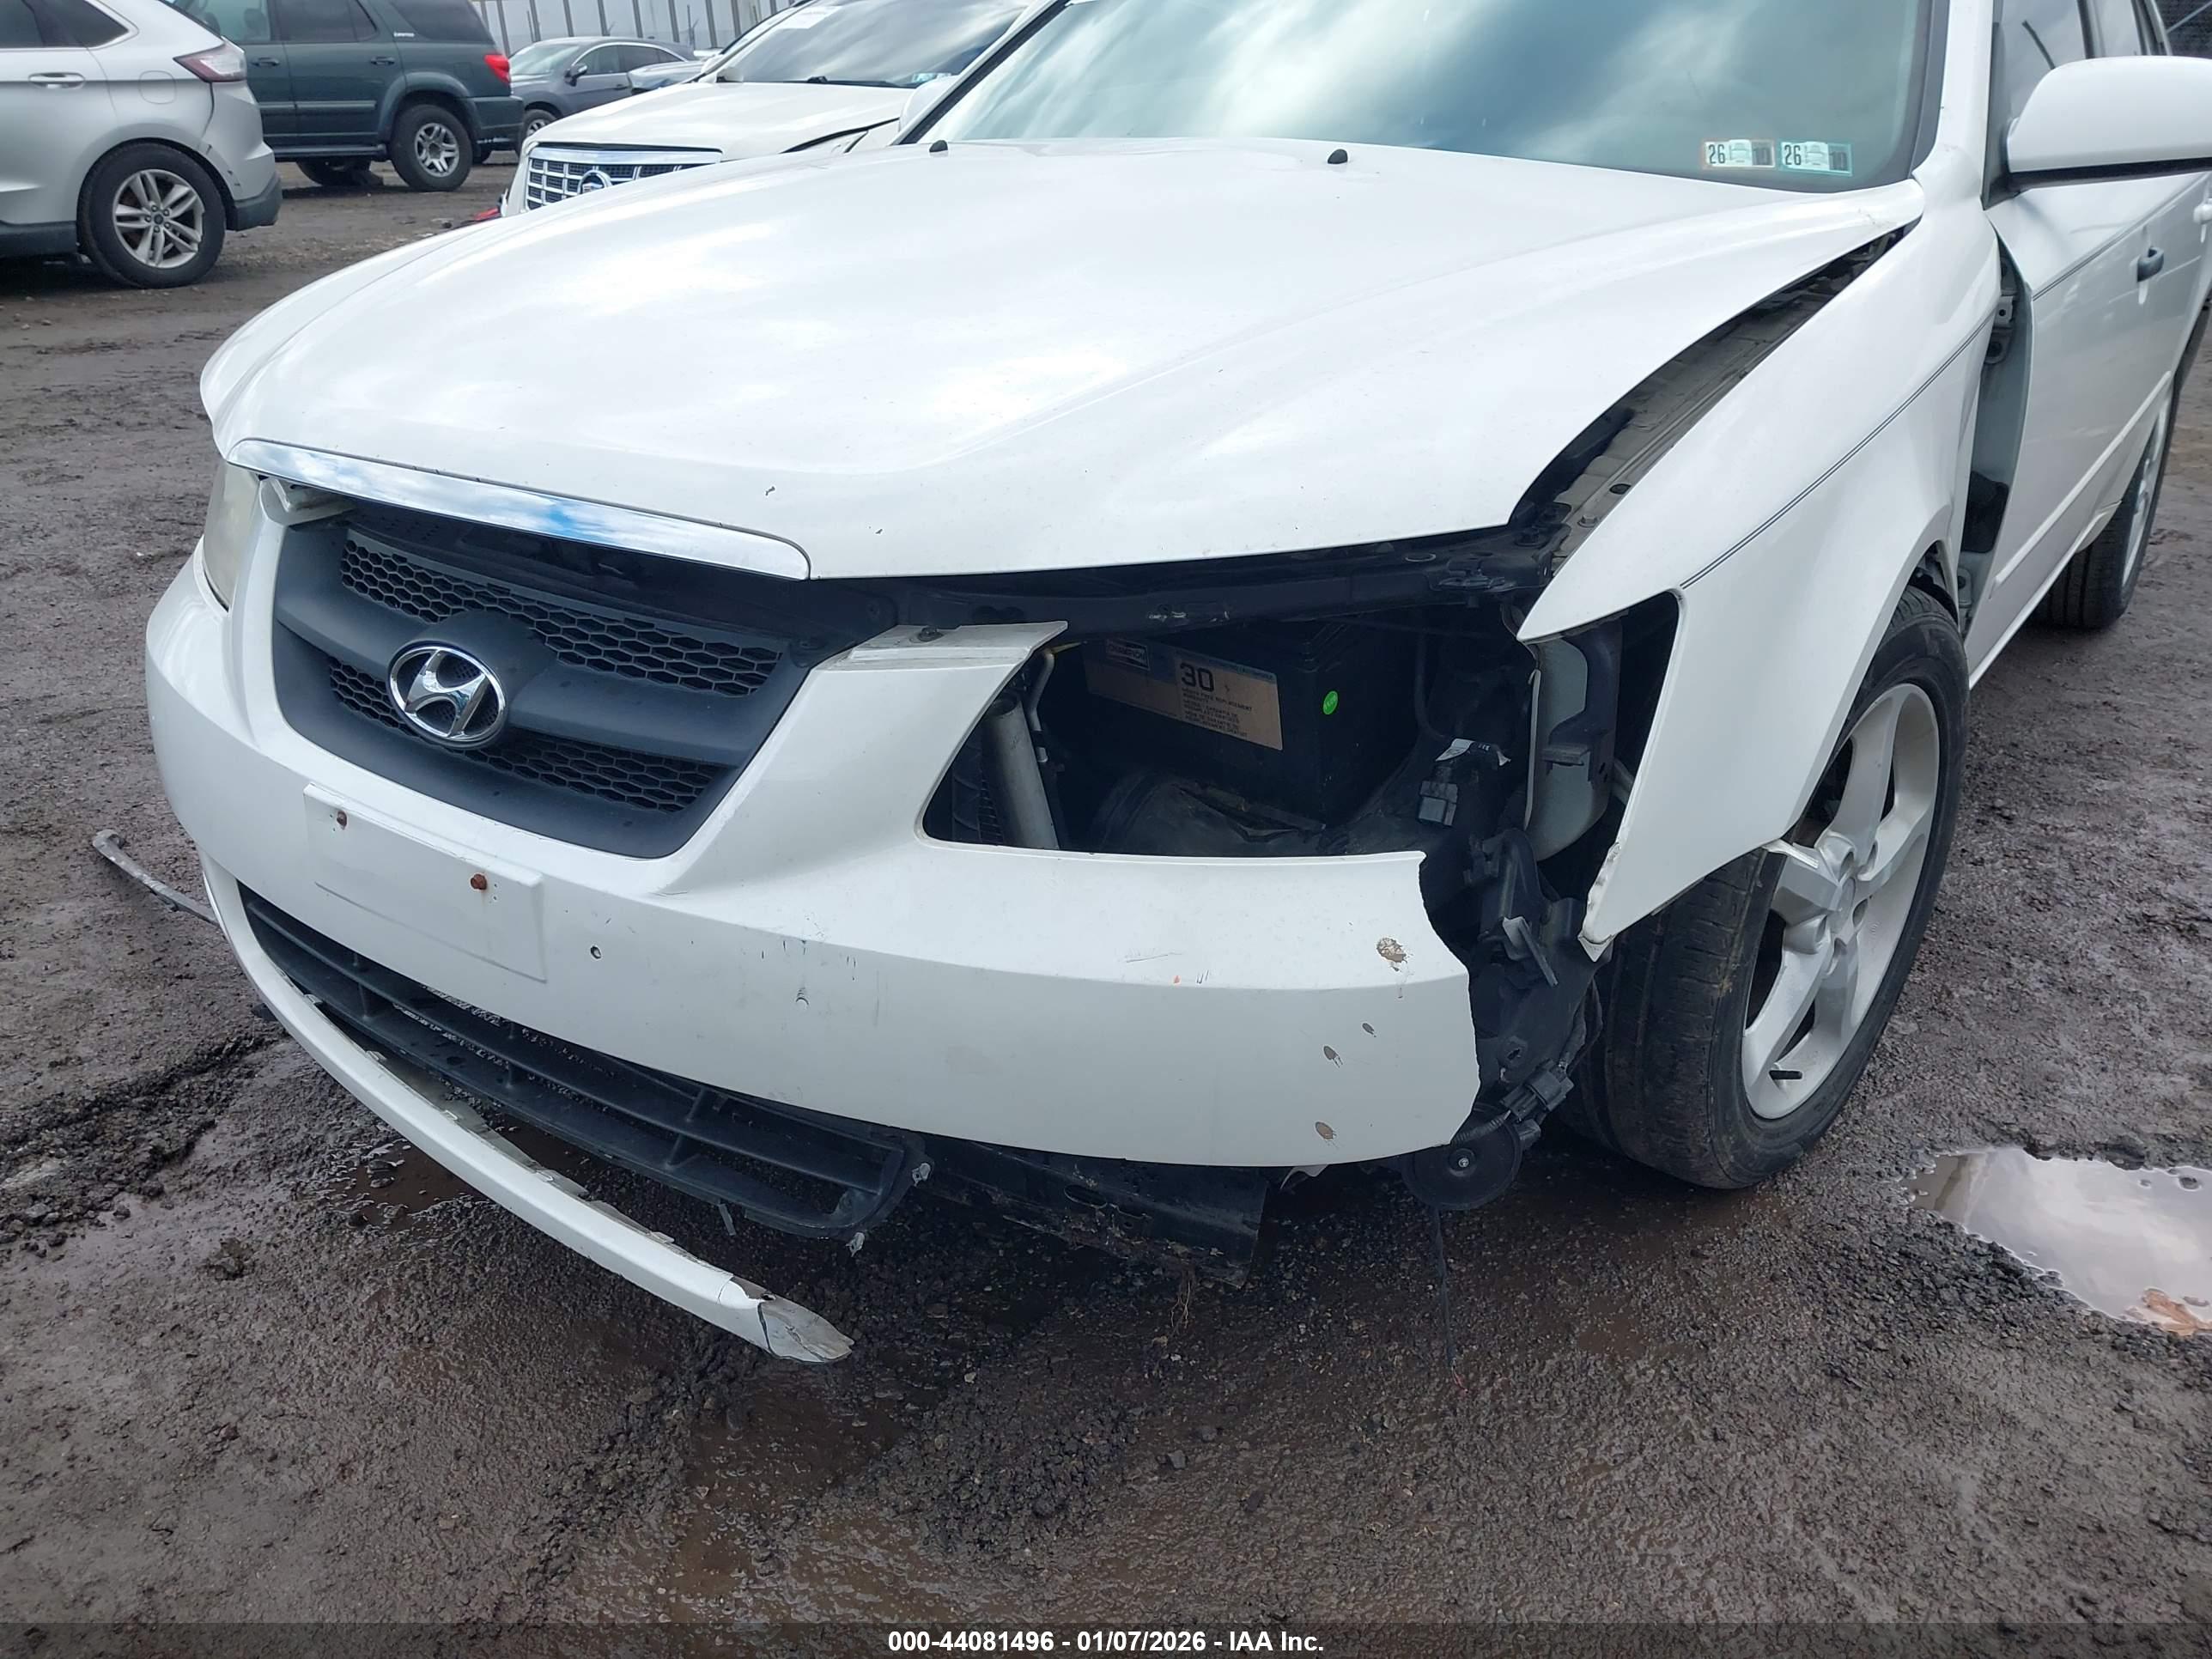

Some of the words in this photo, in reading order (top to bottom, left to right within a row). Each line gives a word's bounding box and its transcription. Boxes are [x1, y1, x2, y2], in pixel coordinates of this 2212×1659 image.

[1708, 143, 1726, 164] 26
[1784, 144, 1802, 166] 26
[1180, 662, 1214, 692] 30
